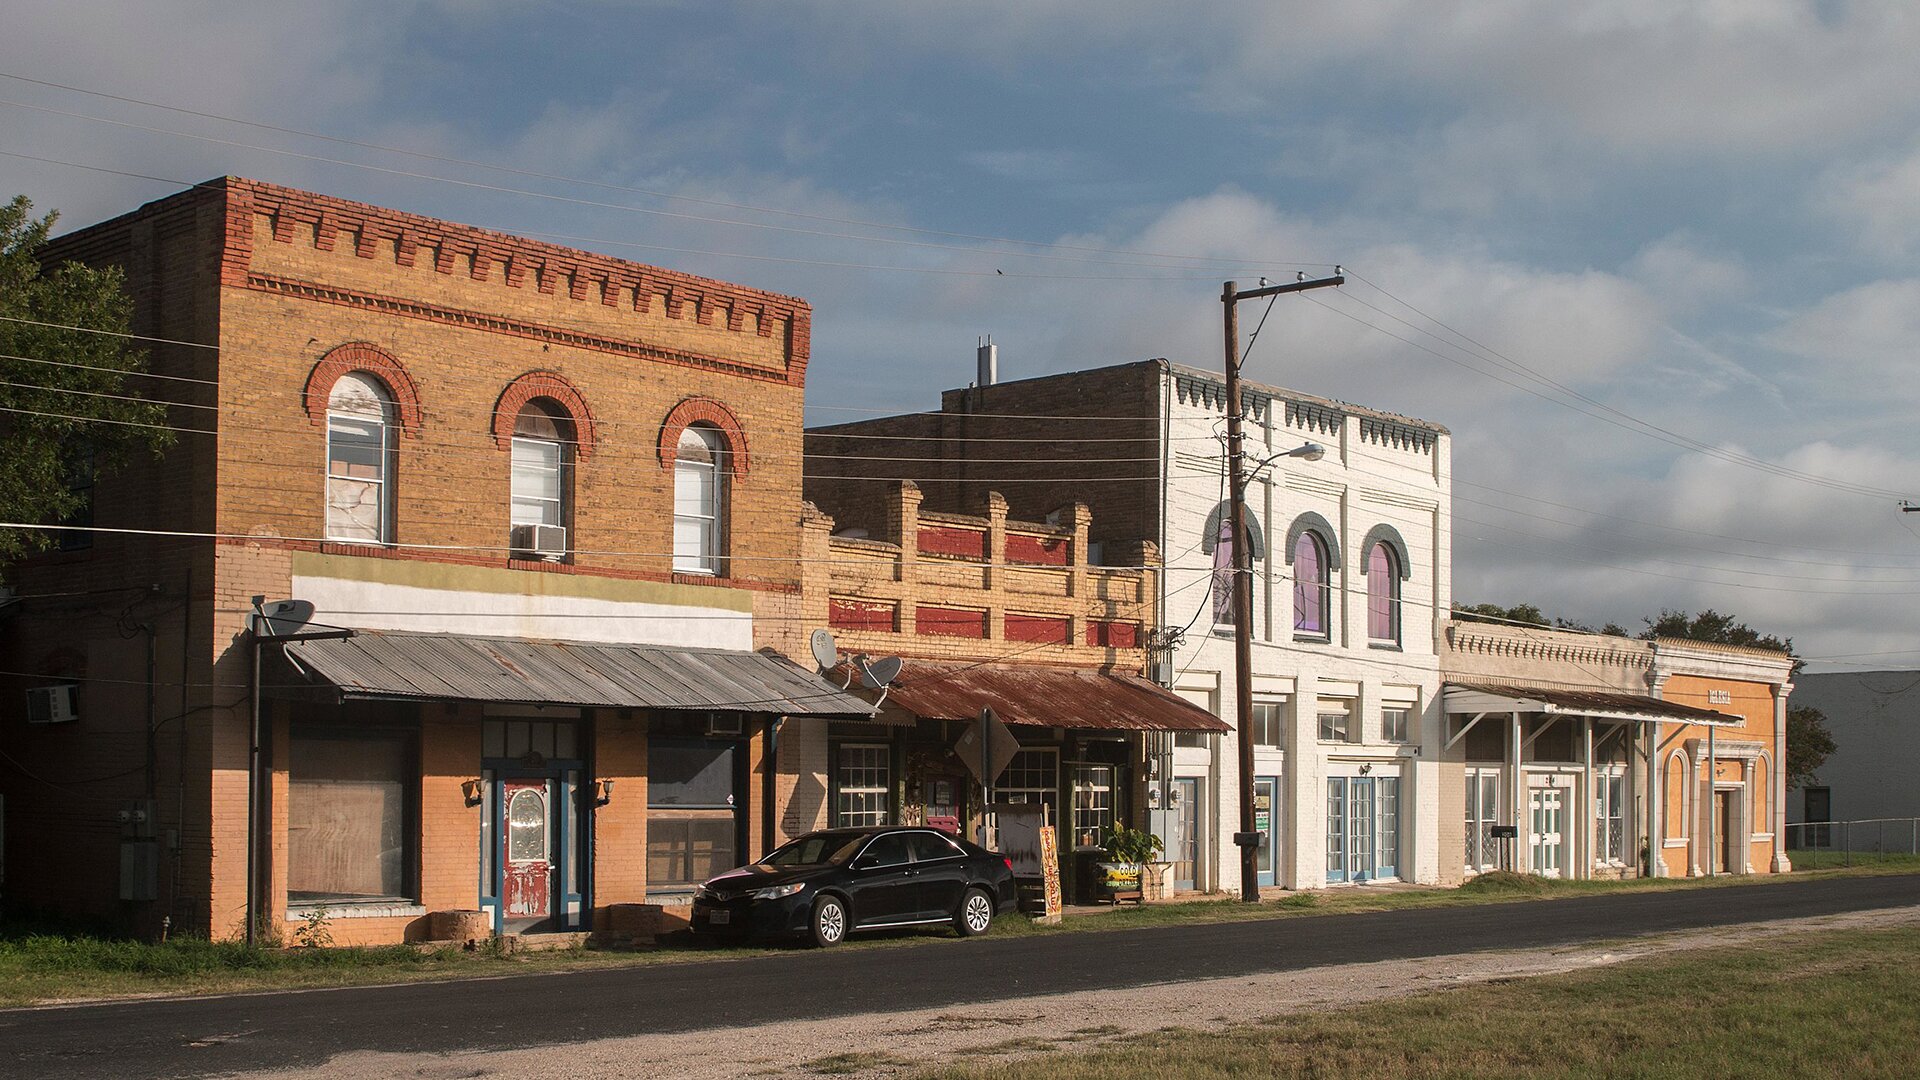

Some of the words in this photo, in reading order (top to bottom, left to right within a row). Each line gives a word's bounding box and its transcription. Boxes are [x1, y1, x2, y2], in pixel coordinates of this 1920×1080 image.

[1708, 690, 1731, 704] IGLESIA
[1120, 865, 1137, 876] COLD
[1049, 881, 1057, 912] OPEN
